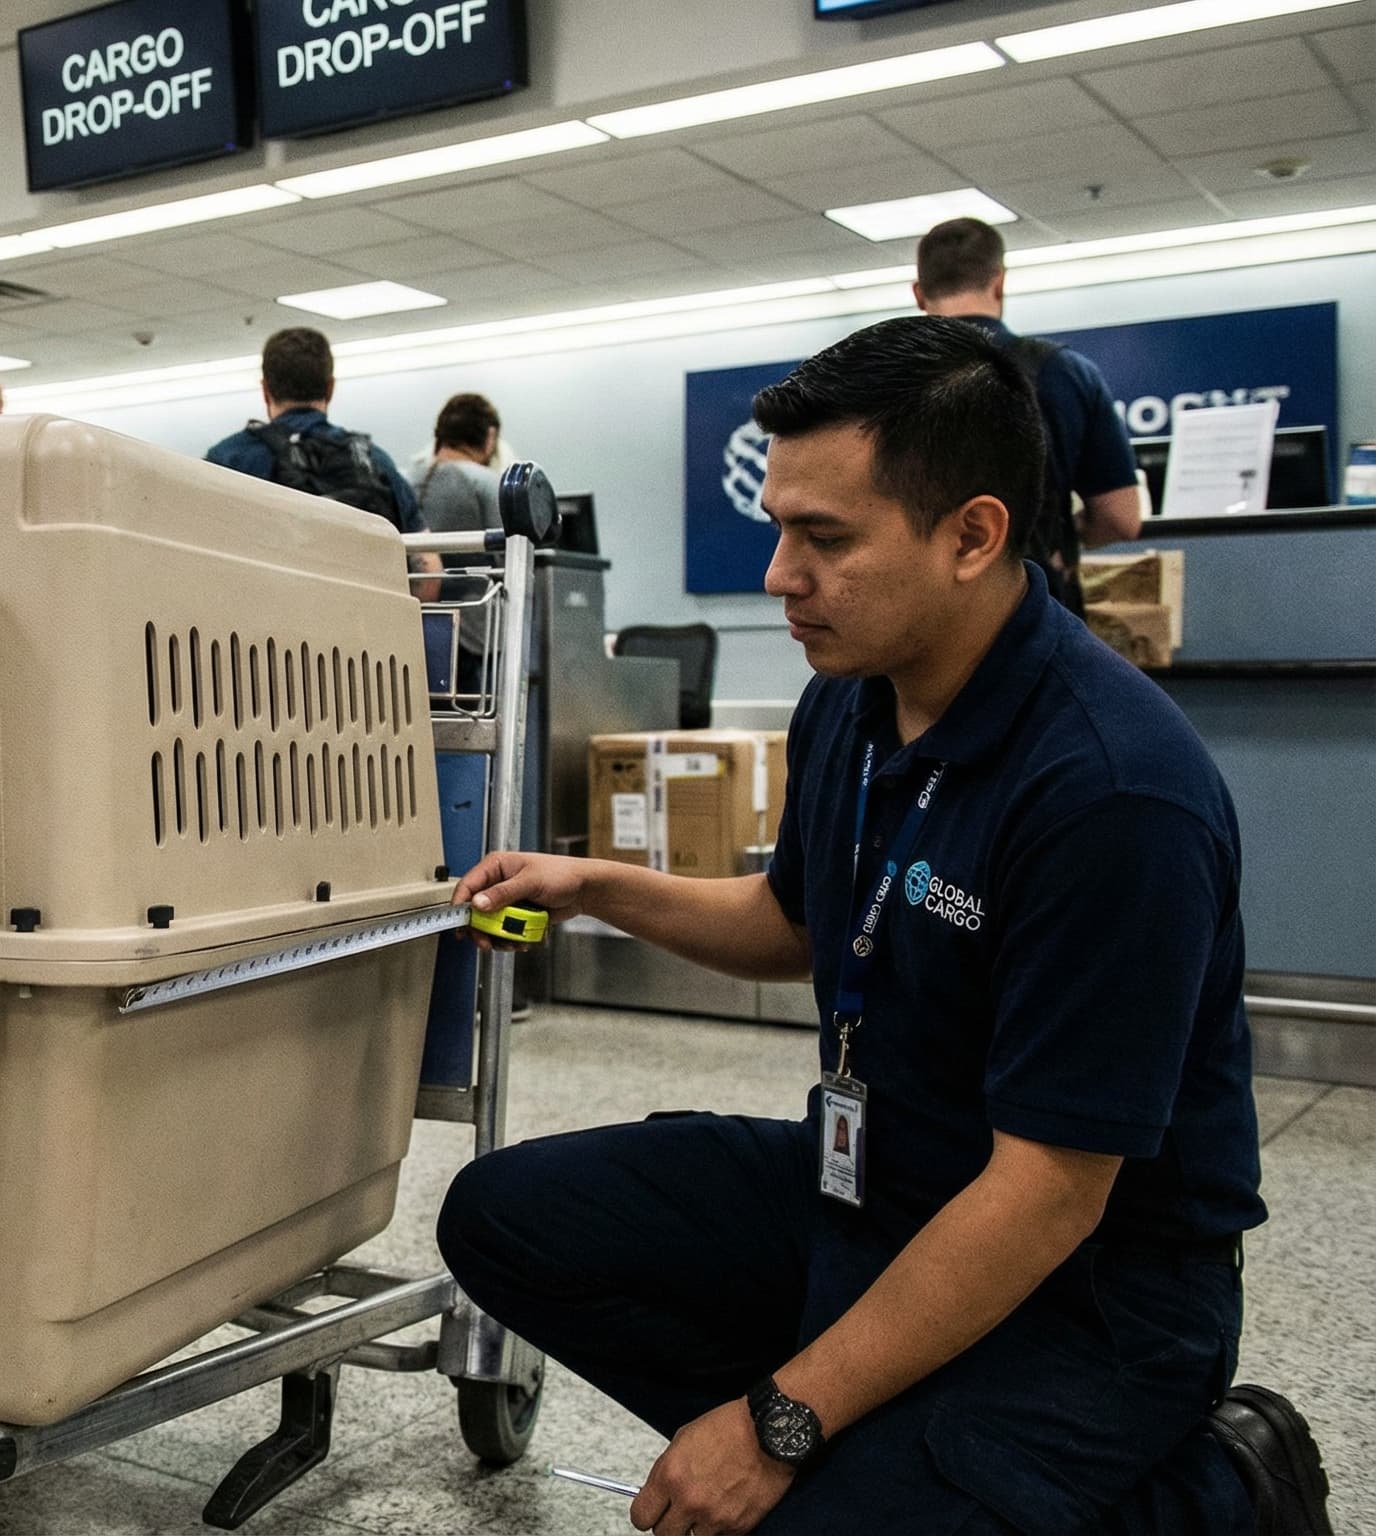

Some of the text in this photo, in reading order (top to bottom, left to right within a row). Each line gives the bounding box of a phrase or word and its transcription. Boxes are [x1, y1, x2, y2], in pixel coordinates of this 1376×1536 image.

[62, 27, 184, 93] CARGO
[277, 0, 488, 88] DROP-OFF
[42, 67, 212, 146] DROP-OFF
[925, 894, 981, 931] CARGO
[929, 876, 985, 917] GLOBAL
